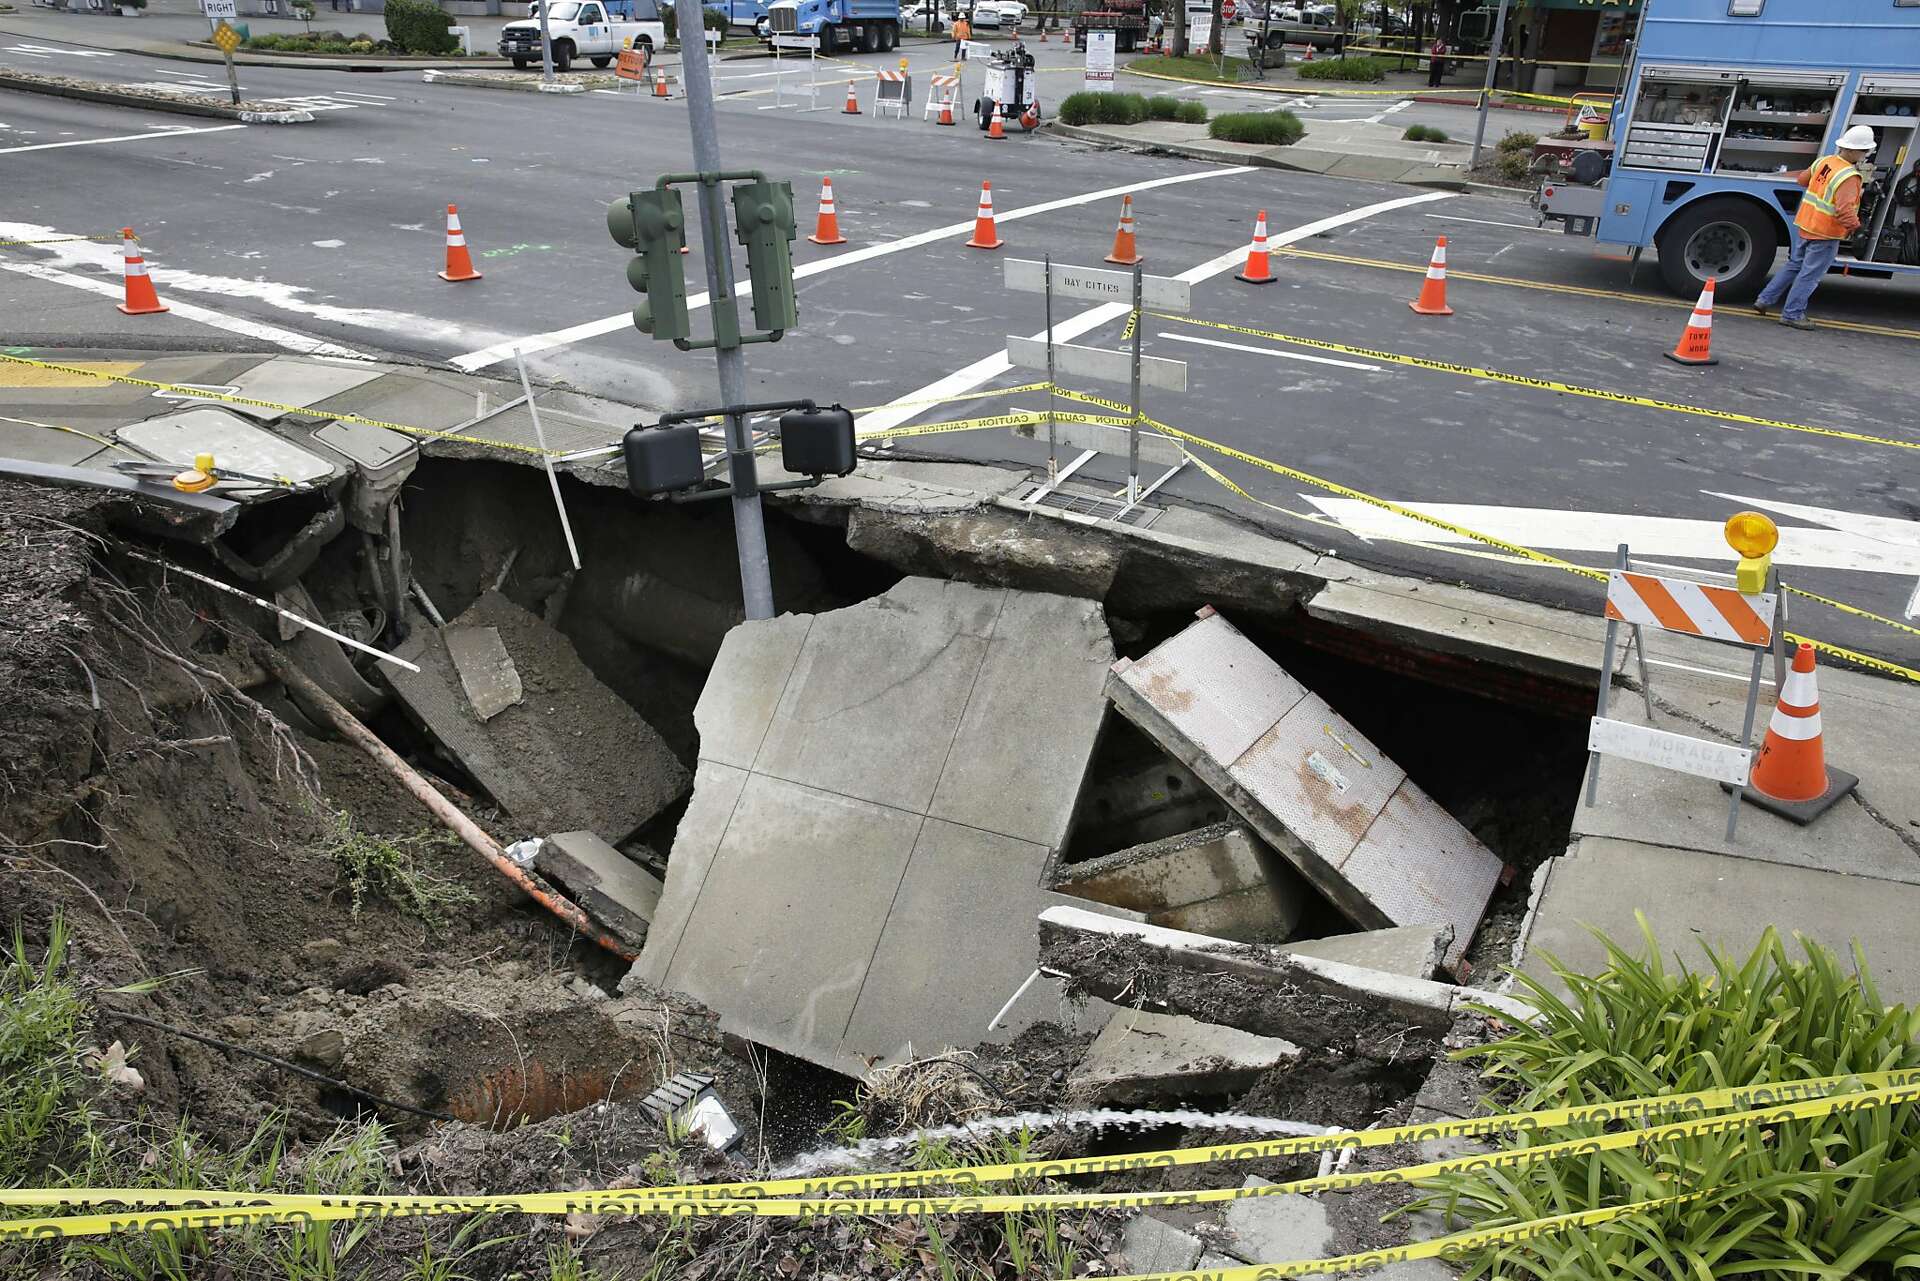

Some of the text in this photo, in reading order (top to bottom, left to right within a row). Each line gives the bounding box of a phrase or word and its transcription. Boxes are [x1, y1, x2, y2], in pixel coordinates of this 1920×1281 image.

[207, 3, 233, 13] RIGHT
[1222, 5, 1235, 13] STOP
[1064, 277, 1119, 294] BAY CITIES
[1648, 735, 1724, 764] MORAGA
